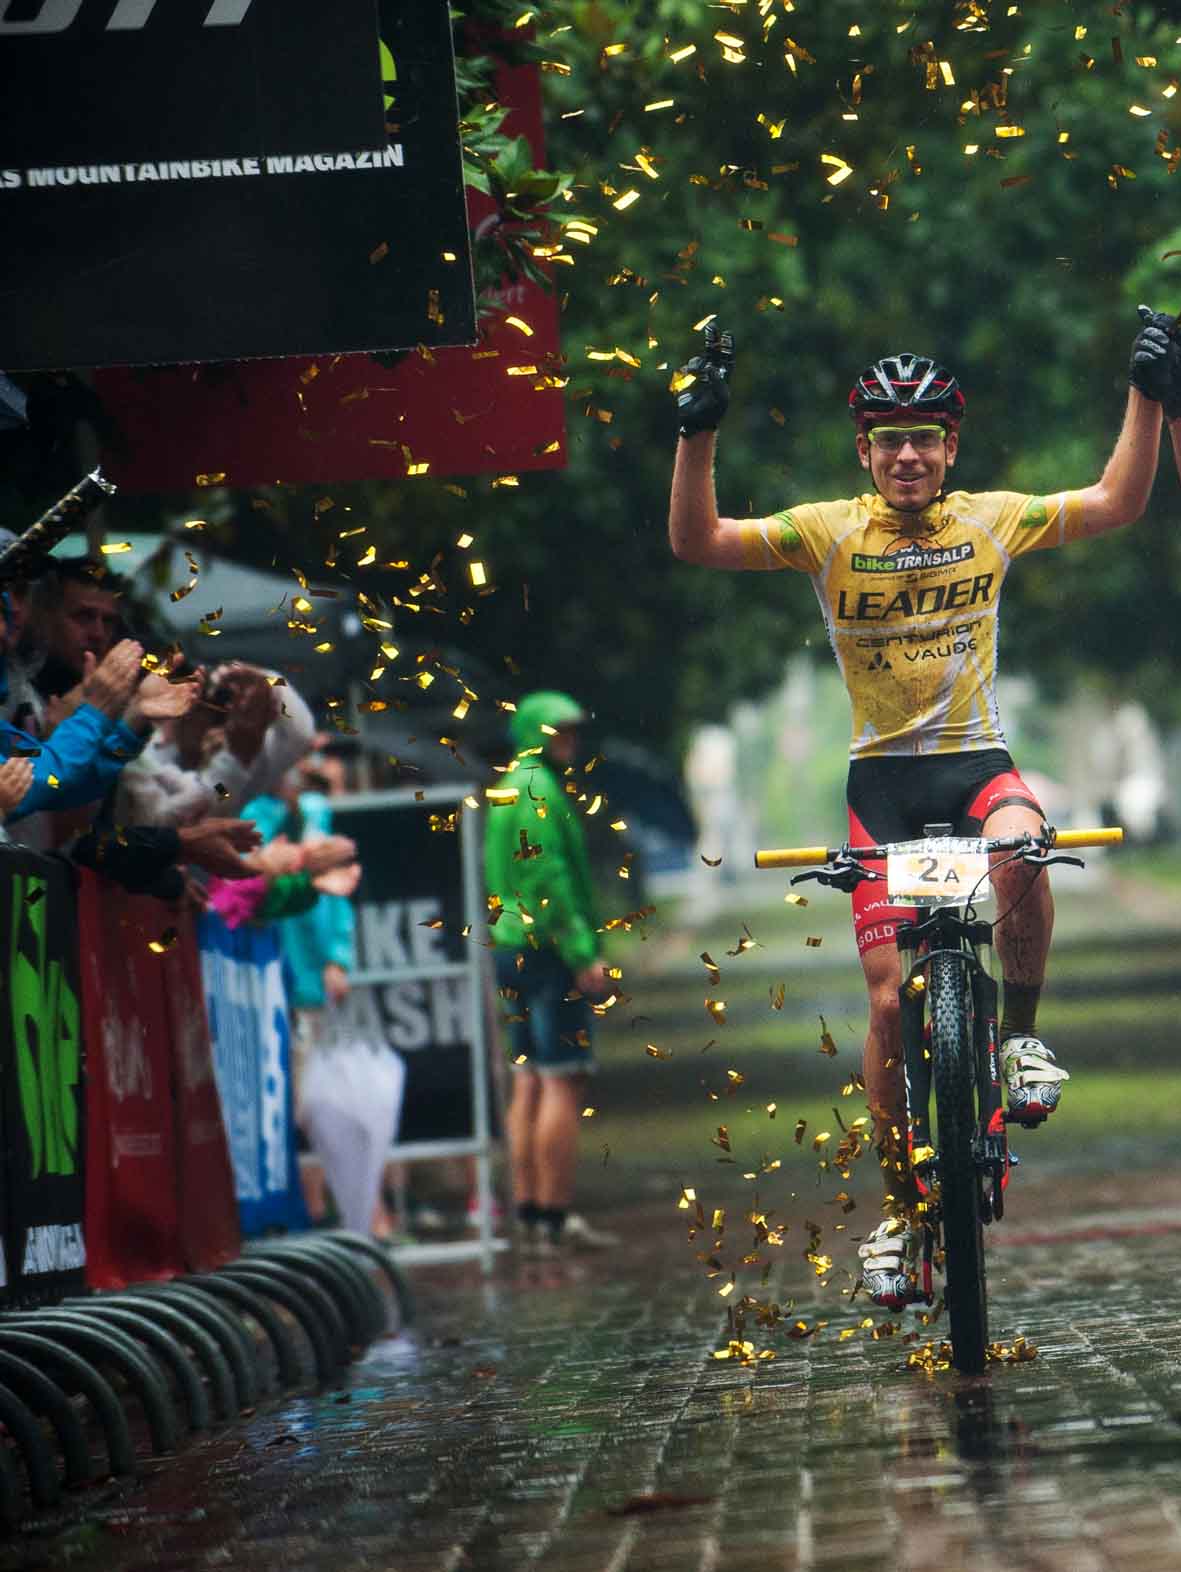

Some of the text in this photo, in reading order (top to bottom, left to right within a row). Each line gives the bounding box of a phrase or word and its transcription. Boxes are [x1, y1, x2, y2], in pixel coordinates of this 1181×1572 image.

[266, 143, 404, 174] MAGAZIN
[837, 572, 994, 621] LEADER
[903, 638, 977, 662] VAUDE
